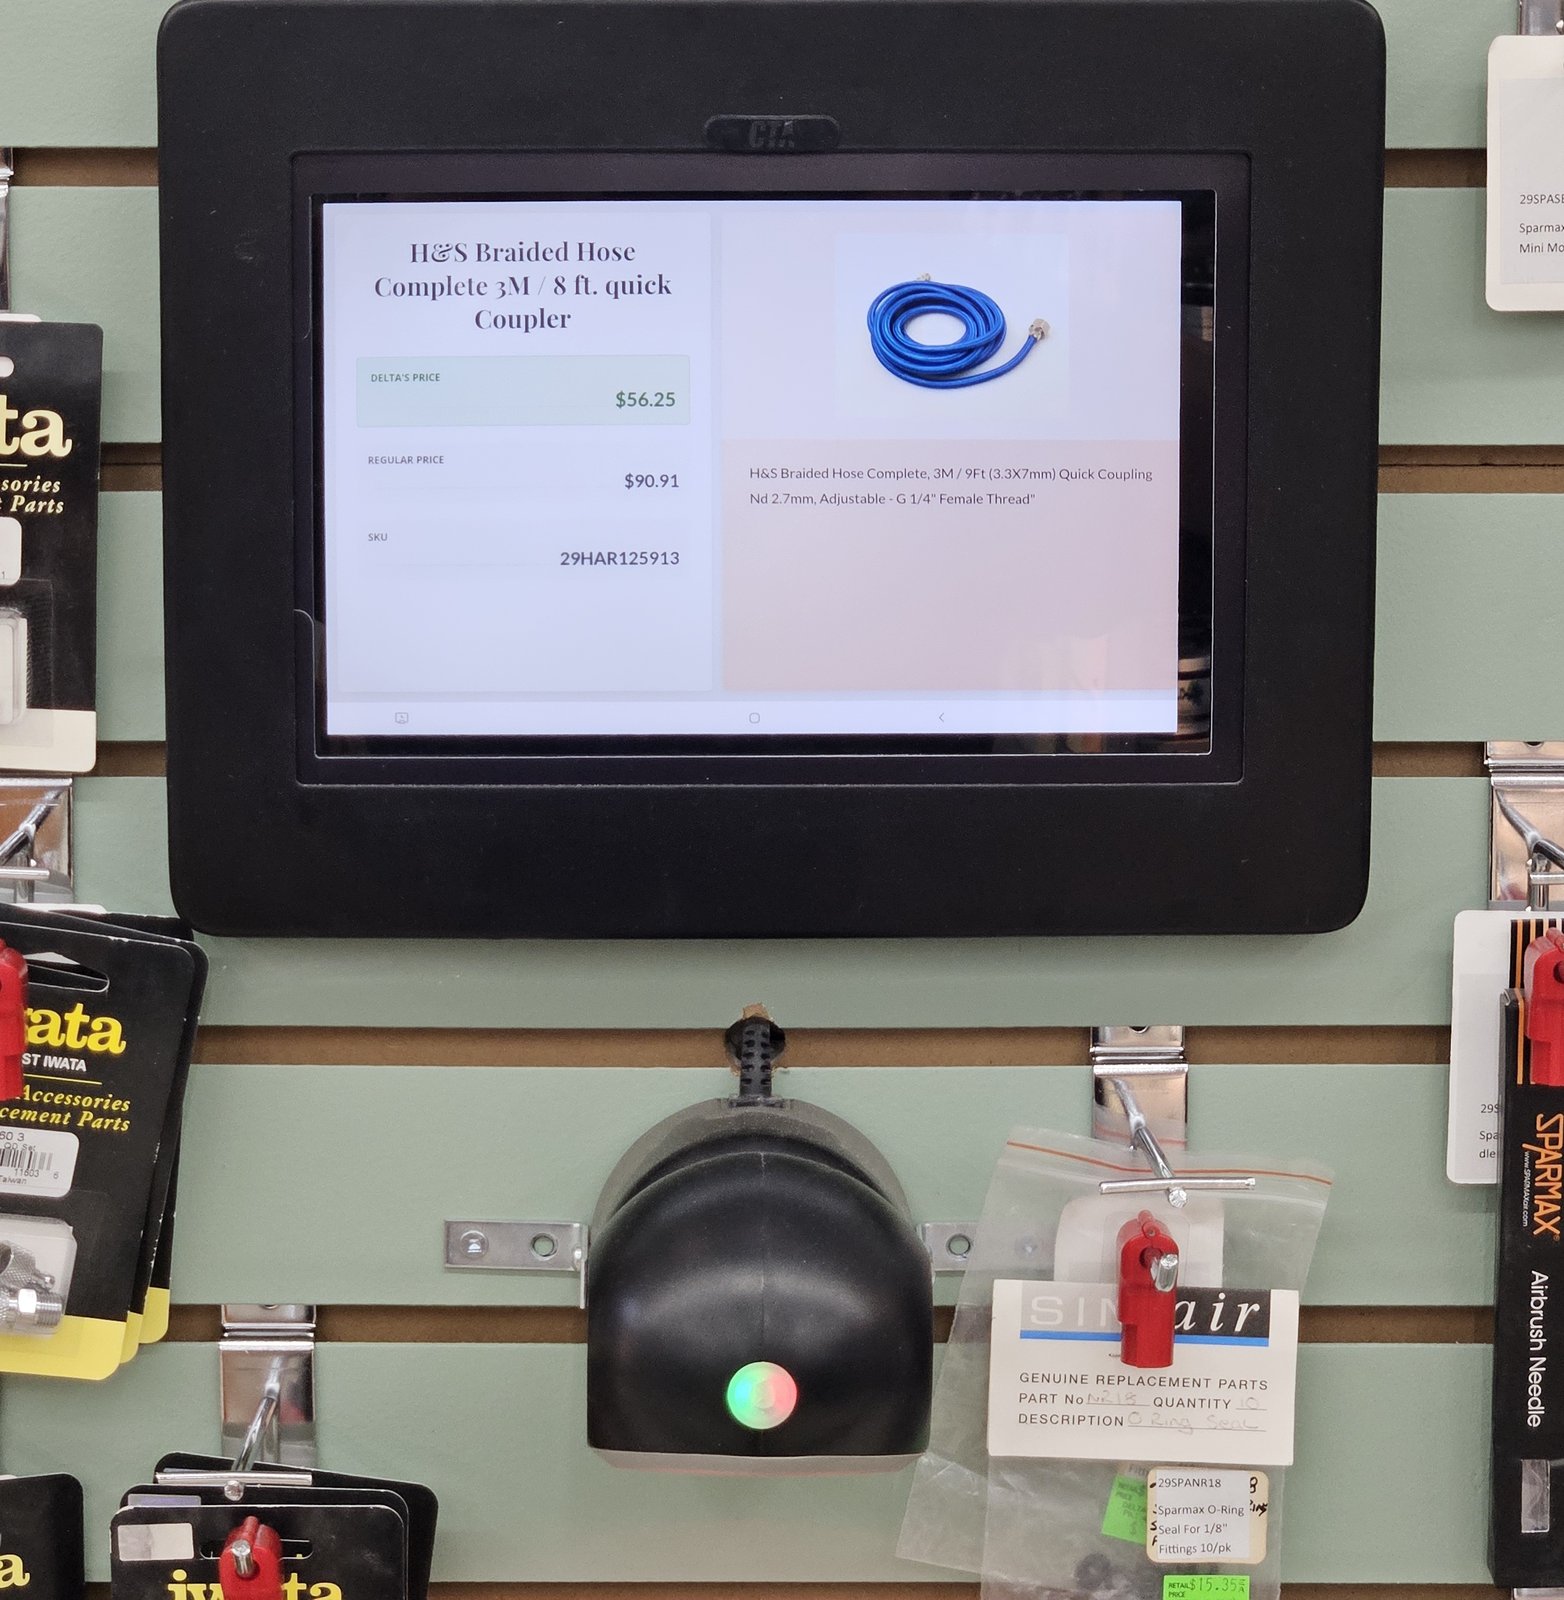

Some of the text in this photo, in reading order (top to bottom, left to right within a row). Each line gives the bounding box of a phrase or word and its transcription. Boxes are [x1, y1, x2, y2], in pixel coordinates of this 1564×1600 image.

[410, 241, 637, 263] H&S Braided Hose
[1519, 242, 1544, 253] Mini
[374, 273, 673, 301] Complete 3M / 8 ft. quick
[474, 307, 572, 333] Coupler
[370, 372, 441, 383] DELTA'S PRICE
[615, 390, 677, 409] $56.25
[368, 455, 445, 465] REGULAR PRICE
[624, 473, 680, 490] $90.91
[749, 468, 1153, 483] H&S Braided Hose Complete, 3M / 9Ft (3.3X7mm) Quick Coupling
[10, 495, 64, 514] Parts
[750, 493, 769, 505] Nd
[771, 493, 817, 507] 2.7mm,
[819, 493, 886, 508] Adjustable
[896, 493, 907, 505] G
[910, 493, 936, 505] 1/4"
[939, 493, 984, 505] Female
[986, 493, 1036, 505] Thread"
[367, 532, 389, 543] SKU
[559, 551, 680, 567] 29HAR125913
[25, 1003, 127, 1054] ata
[43, 1055, 87, 1072] IWATA
[77, 1110, 131, 1132] Parts
[1526, 1270, 1549, 1428] Airbrush Needle
[1019, 1372, 1269, 1391] GENUINE REPLACEMENT PARTS
[1018, 1392, 1058, 1404] PART
[1064, 1393, 1084, 1405] No
[1153, 1396, 1232, 1410] QUANTITY
[1018, 1413, 1125, 1427] DESCRIPTION
[1158, 1477, 1222, 1489] 29SPANR18
[1158, 1504, 1205, 1517] Sparmax
[1207, 1504, 1246, 1517] O-Ring
[1158, 1524, 1182, 1535] Seal
[1184, 1523, 1202, 1535] For
[1159, 1542, 1232, 1556] Fittings 10/pk
